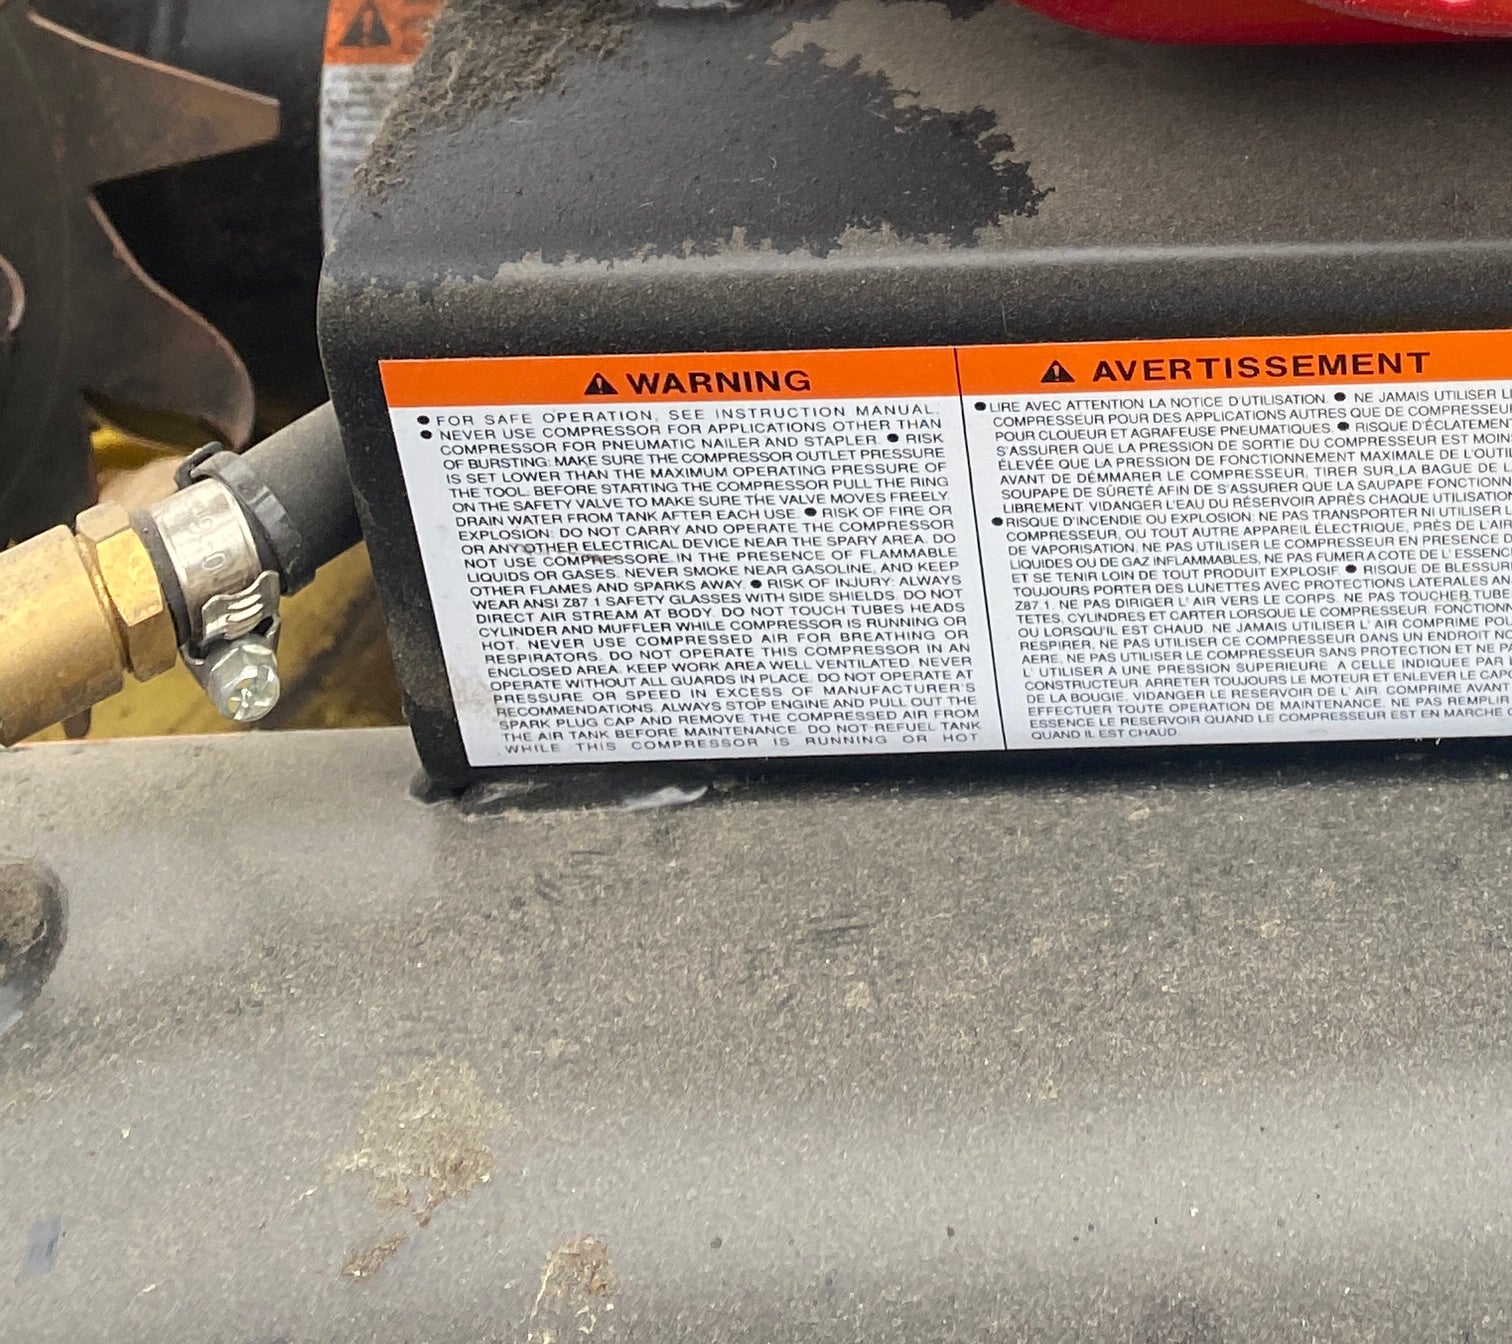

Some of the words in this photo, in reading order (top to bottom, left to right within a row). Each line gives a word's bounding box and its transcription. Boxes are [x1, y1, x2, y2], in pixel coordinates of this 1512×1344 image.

[1092, 351, 1431, 383] AVERTISSEMENT
[626, 369, 811, 395] WARNING
[436, 415, 474, 426] FOR
[484, 413, 531, 425] SAFE
[668, 409, 703, 420] SEE
[715, 406, 844, 419] INSTRUCTION
[992, 414, 1104, 427] COMPRESSEUR
[1108, 413, 1149, 424] POUR
[1152, 411, 1181, 423] DES
[1184, 409, 1286, 422] APPLICATIONS
[1289, 407, 1346, 419] AUTRES
[1349, 406, 1380, 418] QUE
[1384, 406, 1402, 417] DE
[439, 429, 495, 440] NEVER
[502, 428, 534, 439] USE
[542, 424, 660, 438] COMPRESSOR
[667, 423, 701, 434] FOR
[707, 421, 826, 433] APPLICATIONS
[832, 419, 890, 431] OTHER
[897, 418, 941, 429] THAN
